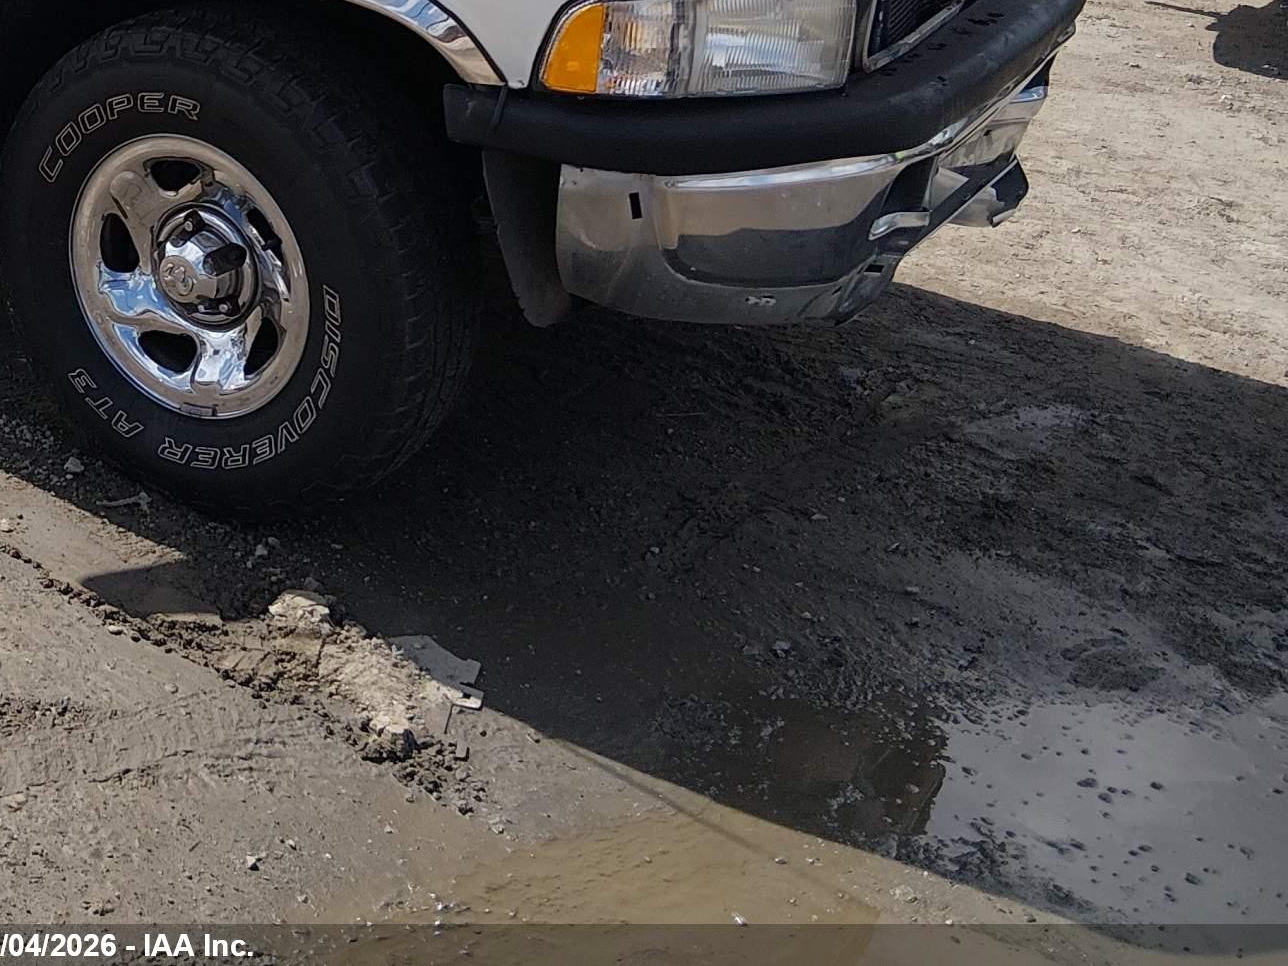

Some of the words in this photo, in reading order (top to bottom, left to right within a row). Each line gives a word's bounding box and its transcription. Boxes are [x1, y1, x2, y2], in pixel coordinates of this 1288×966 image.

[38, 91, 201, 183] COOPER
[68, 367, 145, 439] AT3
[158, 285, 342, 470] DISCOVERER
